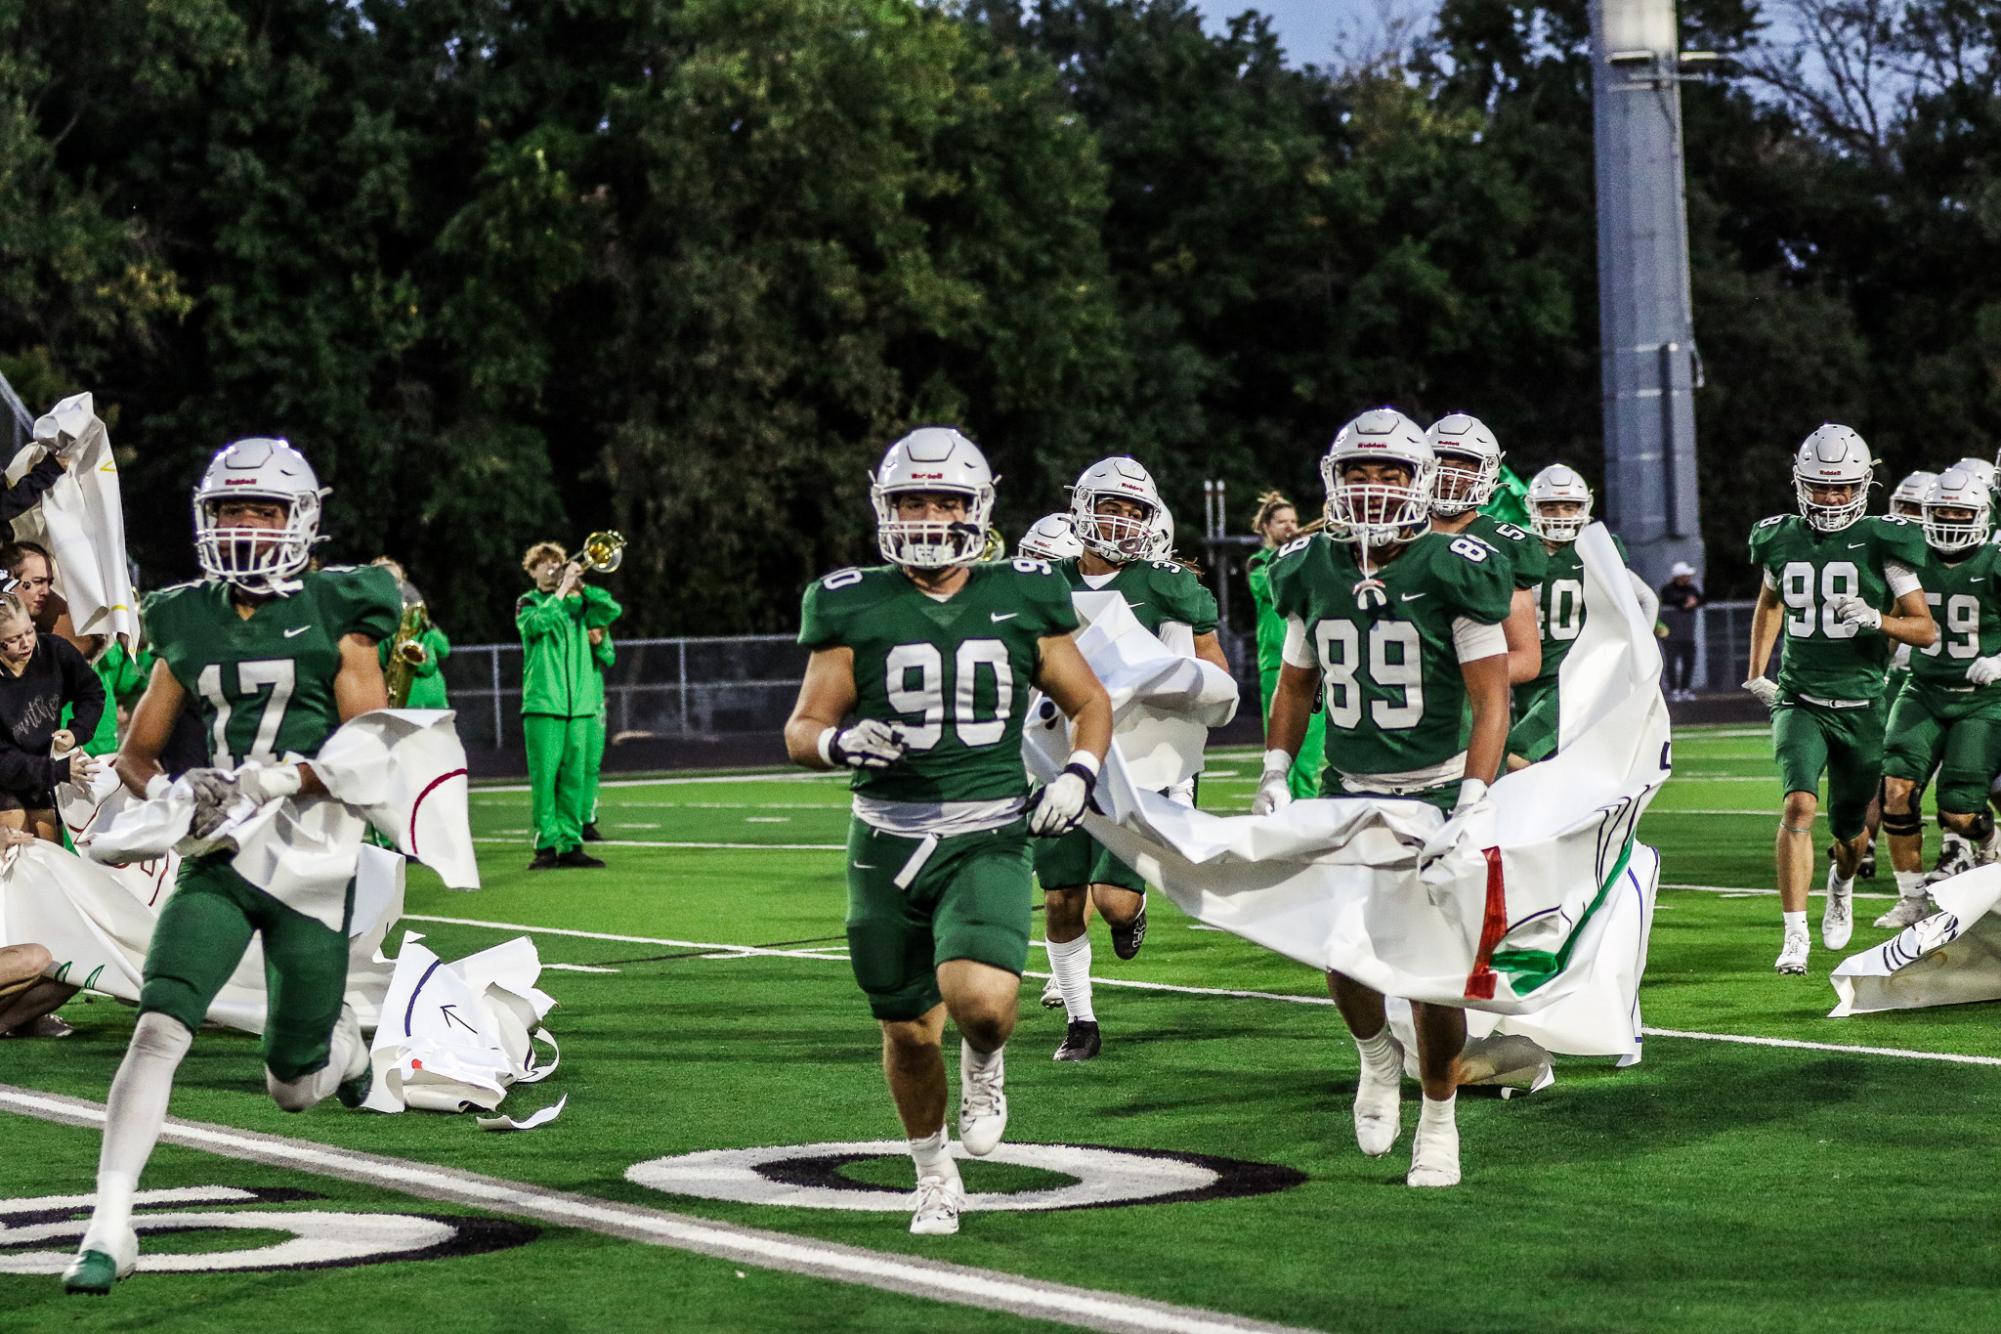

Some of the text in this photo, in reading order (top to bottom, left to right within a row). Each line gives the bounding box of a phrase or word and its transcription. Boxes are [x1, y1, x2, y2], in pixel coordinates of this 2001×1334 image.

[1783, 561, 1859, 638] 98
[197, 658, 295, 770] 17
[886, 639, 1013, 749] 90
[1315, 618, 1424, 729] 89
